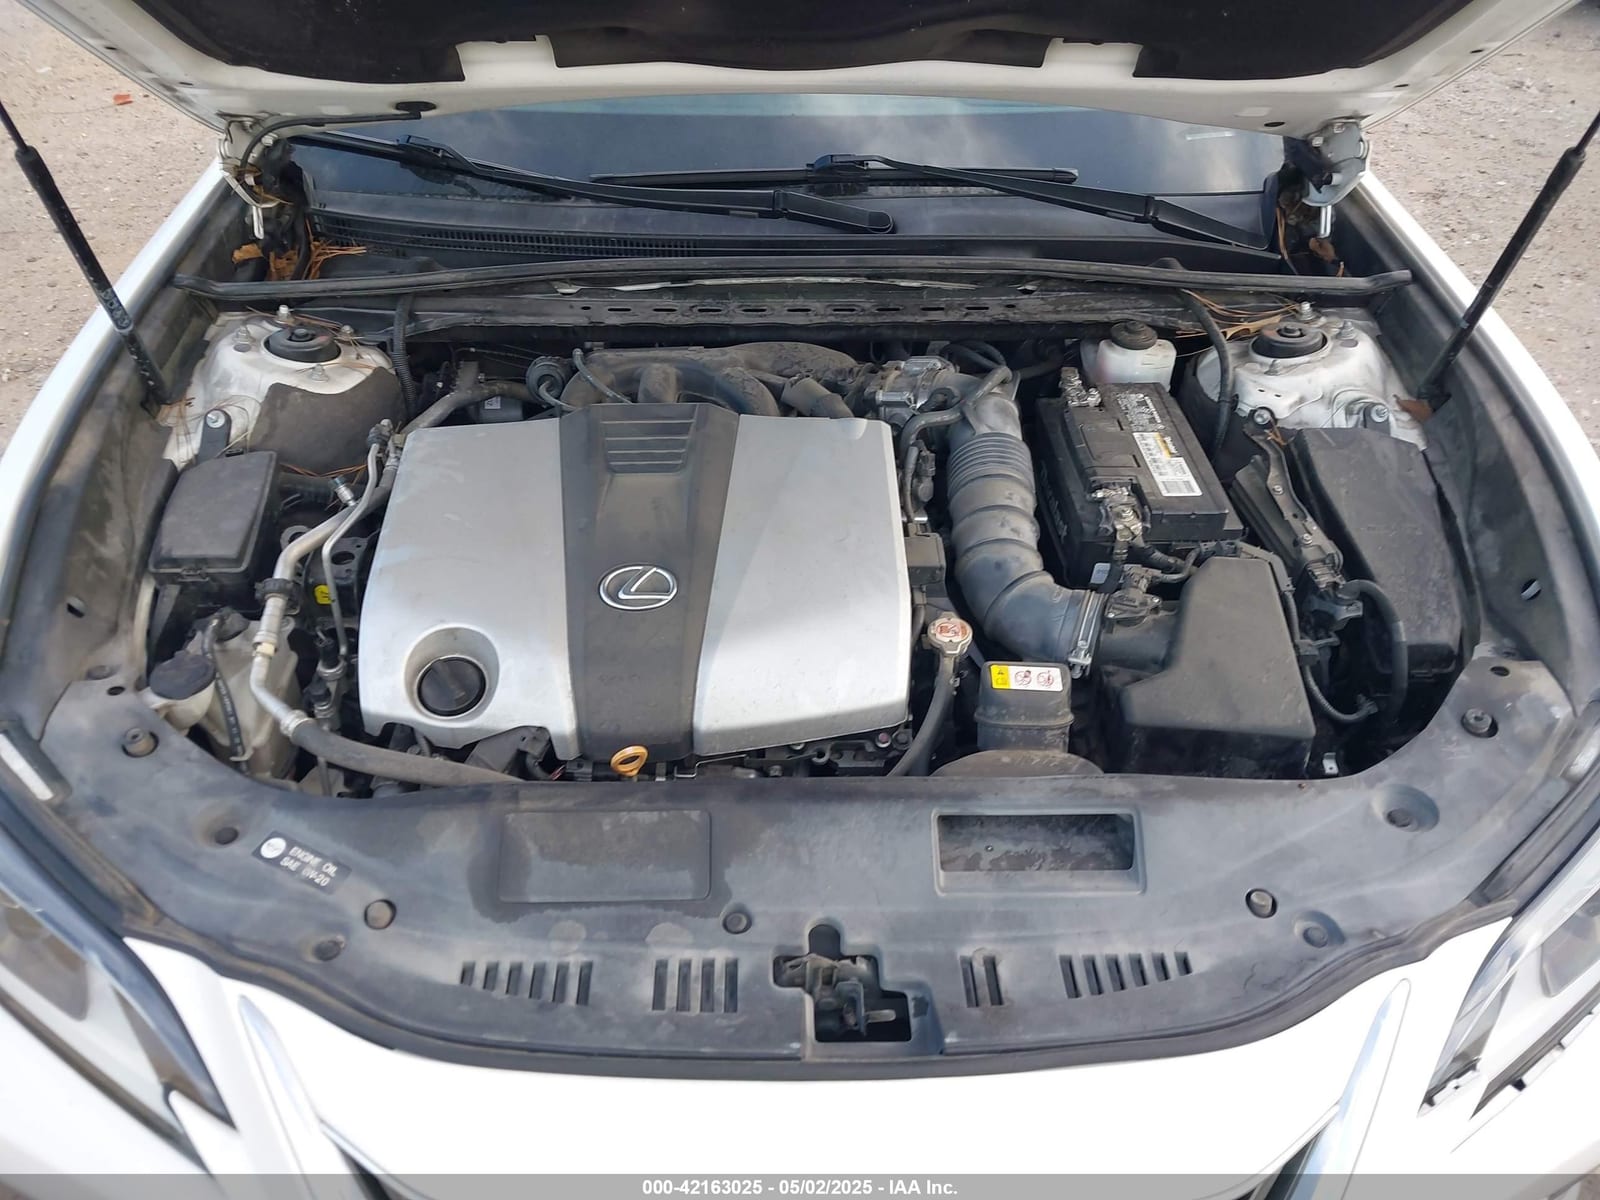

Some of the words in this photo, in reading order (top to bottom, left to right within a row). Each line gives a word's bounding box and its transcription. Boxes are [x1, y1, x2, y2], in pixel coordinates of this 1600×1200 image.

[280, 856, 302, 871] SAE
[288, 846, 323, 865] ENGINE
[322, 862, 339, 878] OIL
